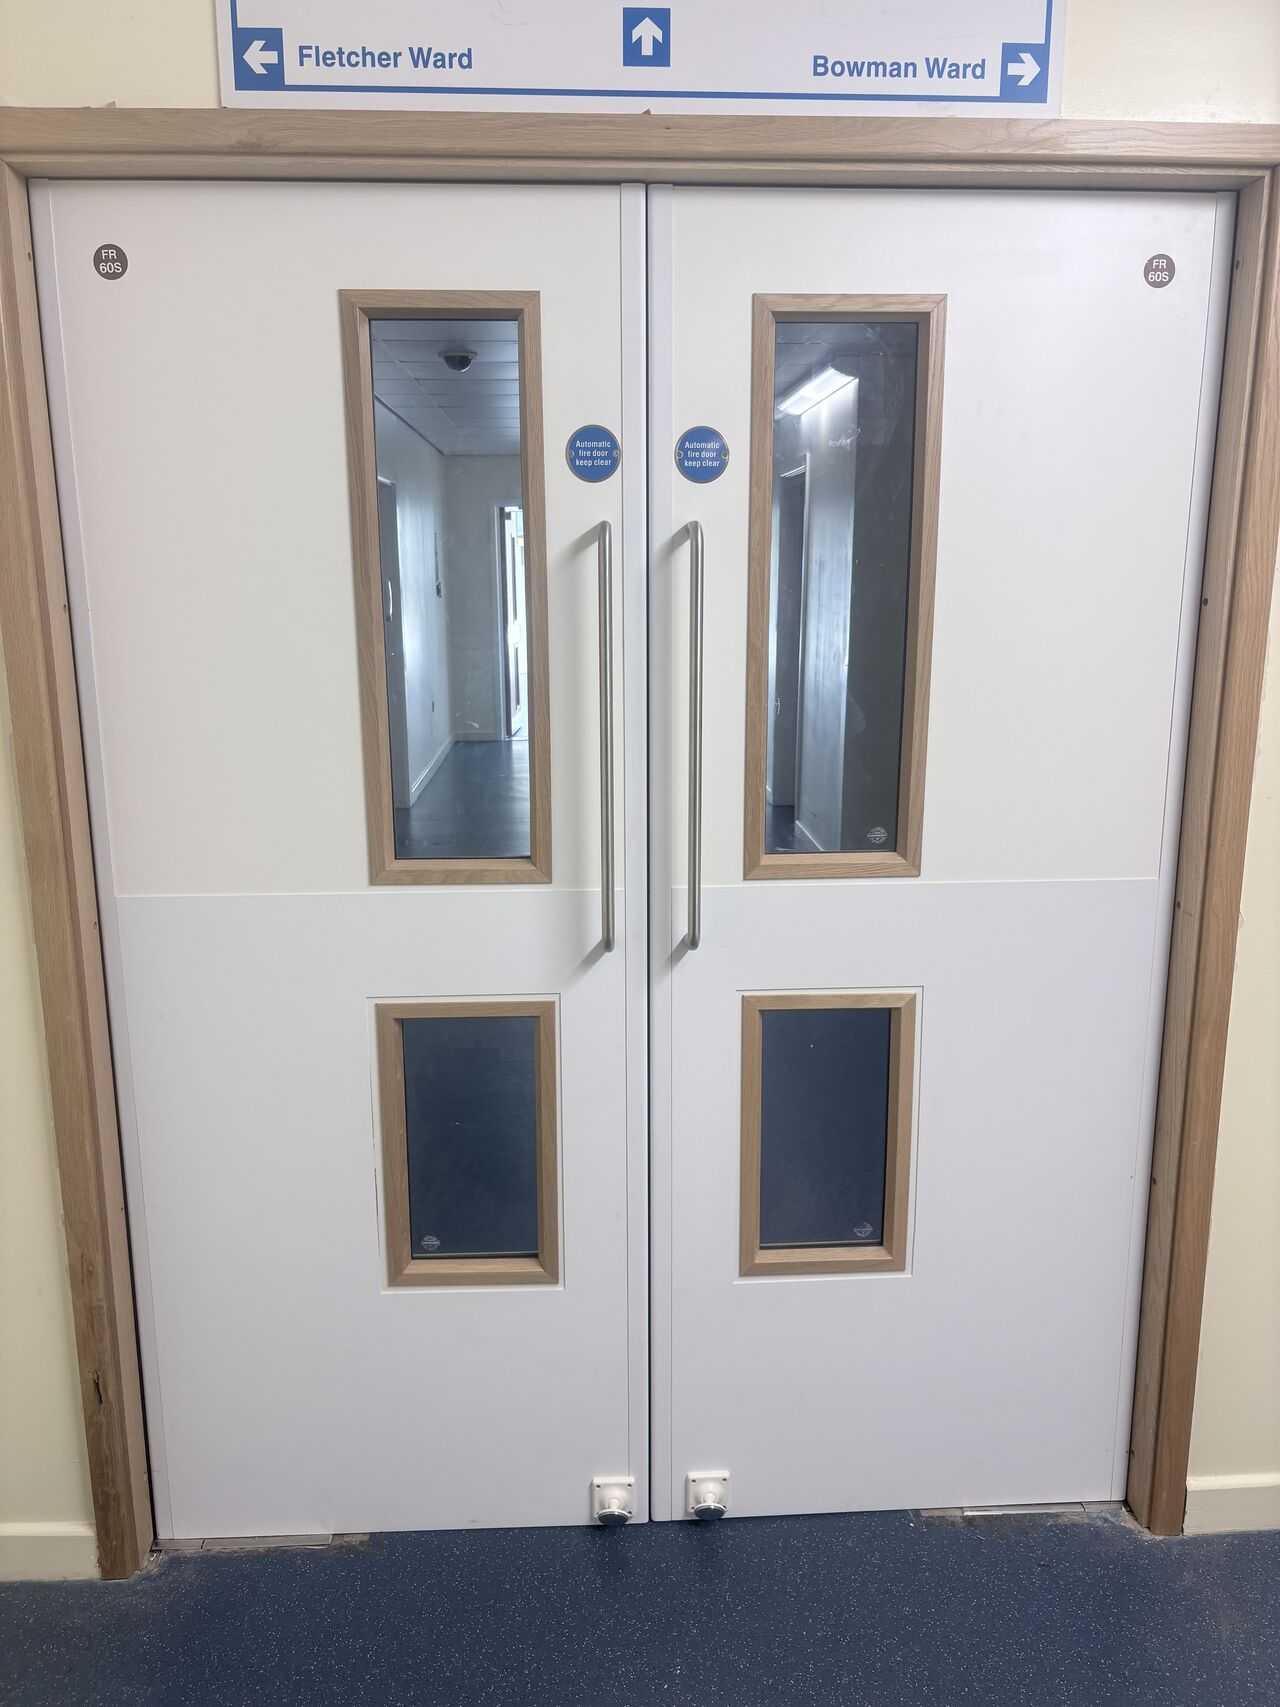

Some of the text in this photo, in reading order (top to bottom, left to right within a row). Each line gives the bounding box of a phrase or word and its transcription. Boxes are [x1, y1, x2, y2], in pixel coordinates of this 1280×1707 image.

[298, 45, 473, 69] Fletcher Ward
[812, 55, 986, 80] Bowman Ward
[101, 249, 117, 260] FR
[99, 262, 122, 273] 60S
[1152, 259, 1167, 269] FR
[1148, 271, 1169, 282] 60S
[575, 440, 611, 448] Automatic
[684, 441, 720, 449] Automatic
[578, 449, 608, 457] fire door
[687, 450, 717, 458] fire door
[575, 459, 592, 467] keep
[684, 460, 701, 468] keep
